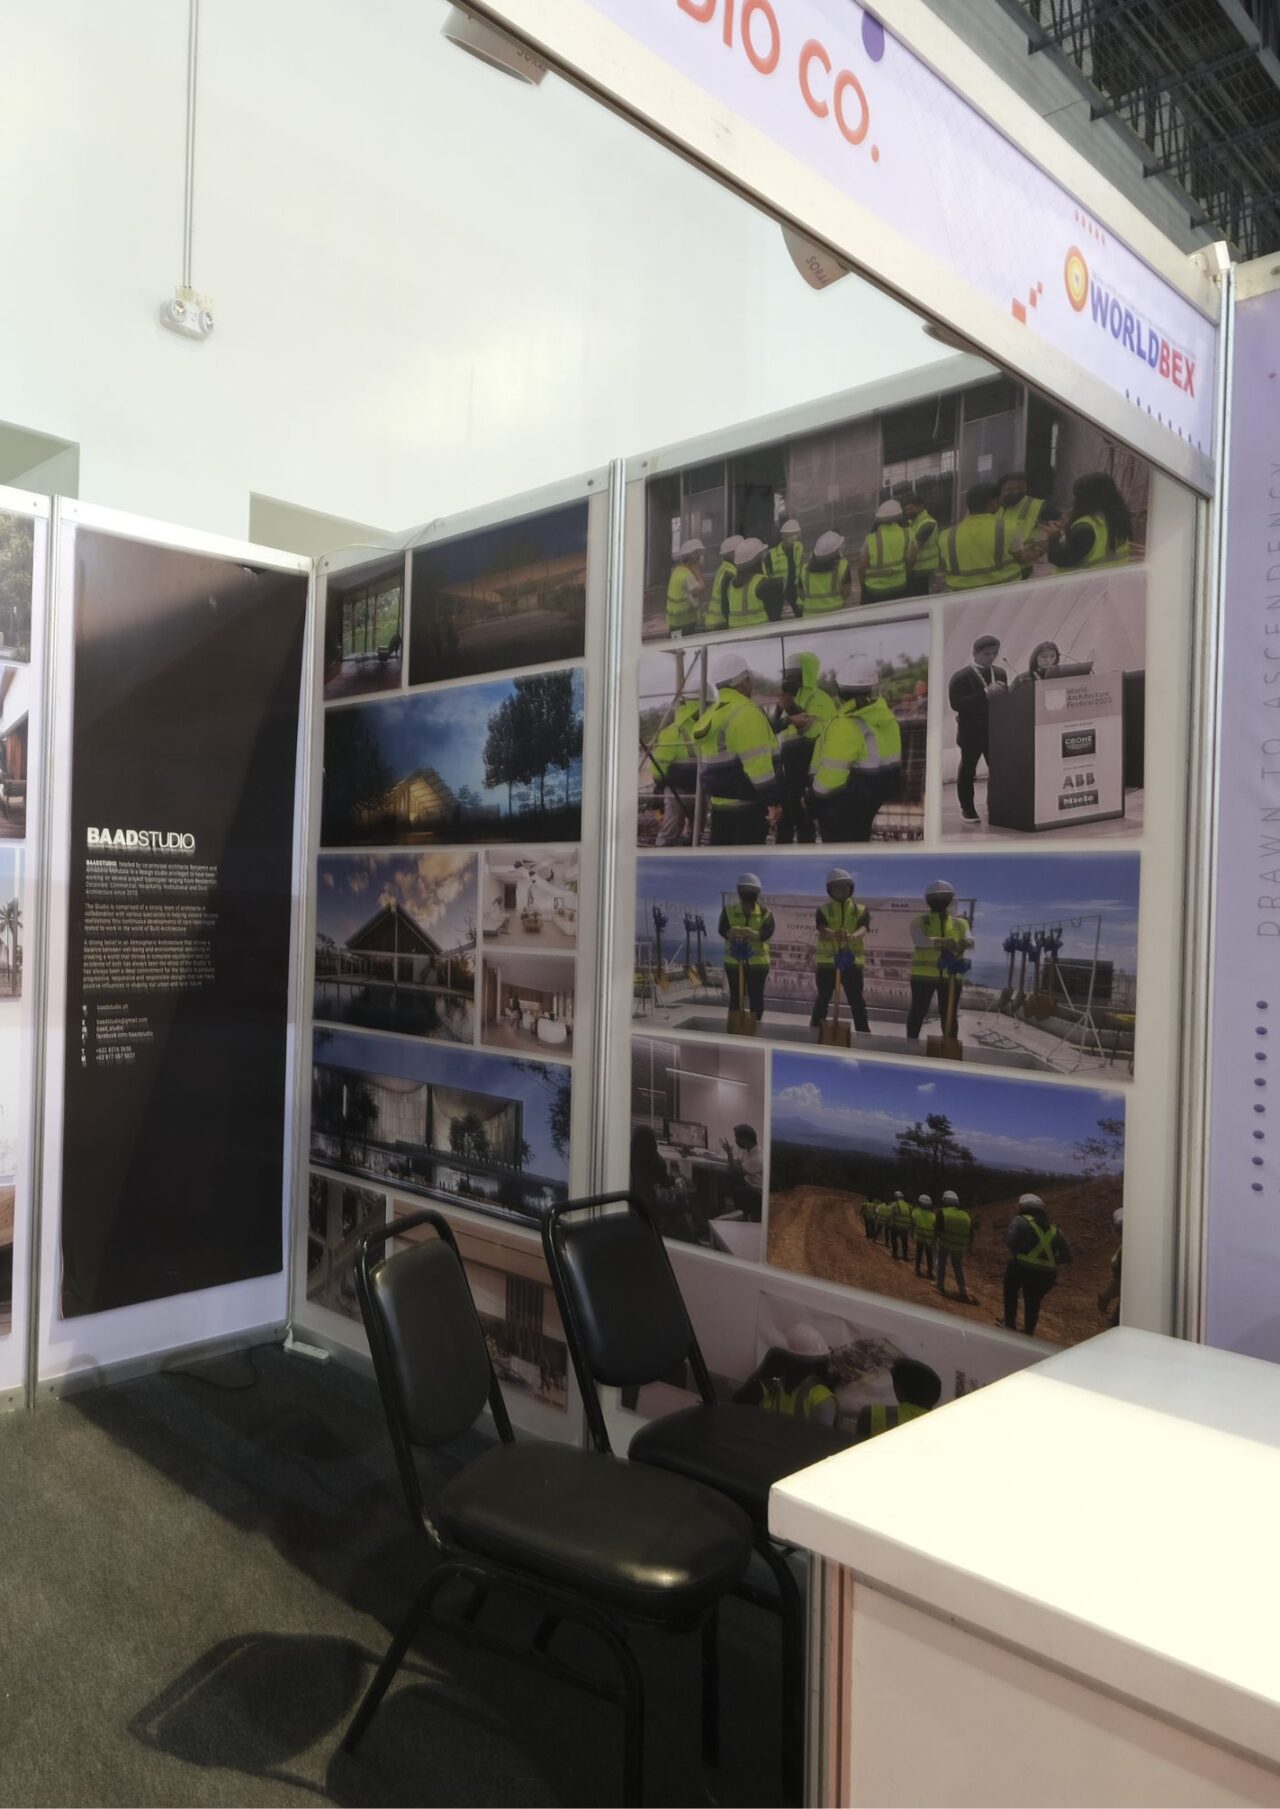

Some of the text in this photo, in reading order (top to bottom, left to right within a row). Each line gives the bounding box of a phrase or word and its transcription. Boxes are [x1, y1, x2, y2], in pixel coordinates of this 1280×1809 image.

[677, 0, 880, 163] IO CO.
[1091, 279, 1195, 399] WORLDBEX
[1062, 772, 1096, 789] ABB
[1063, 795, 1094, 806] Miele
[87, 827, 195, 849] BAADSTUDIO
